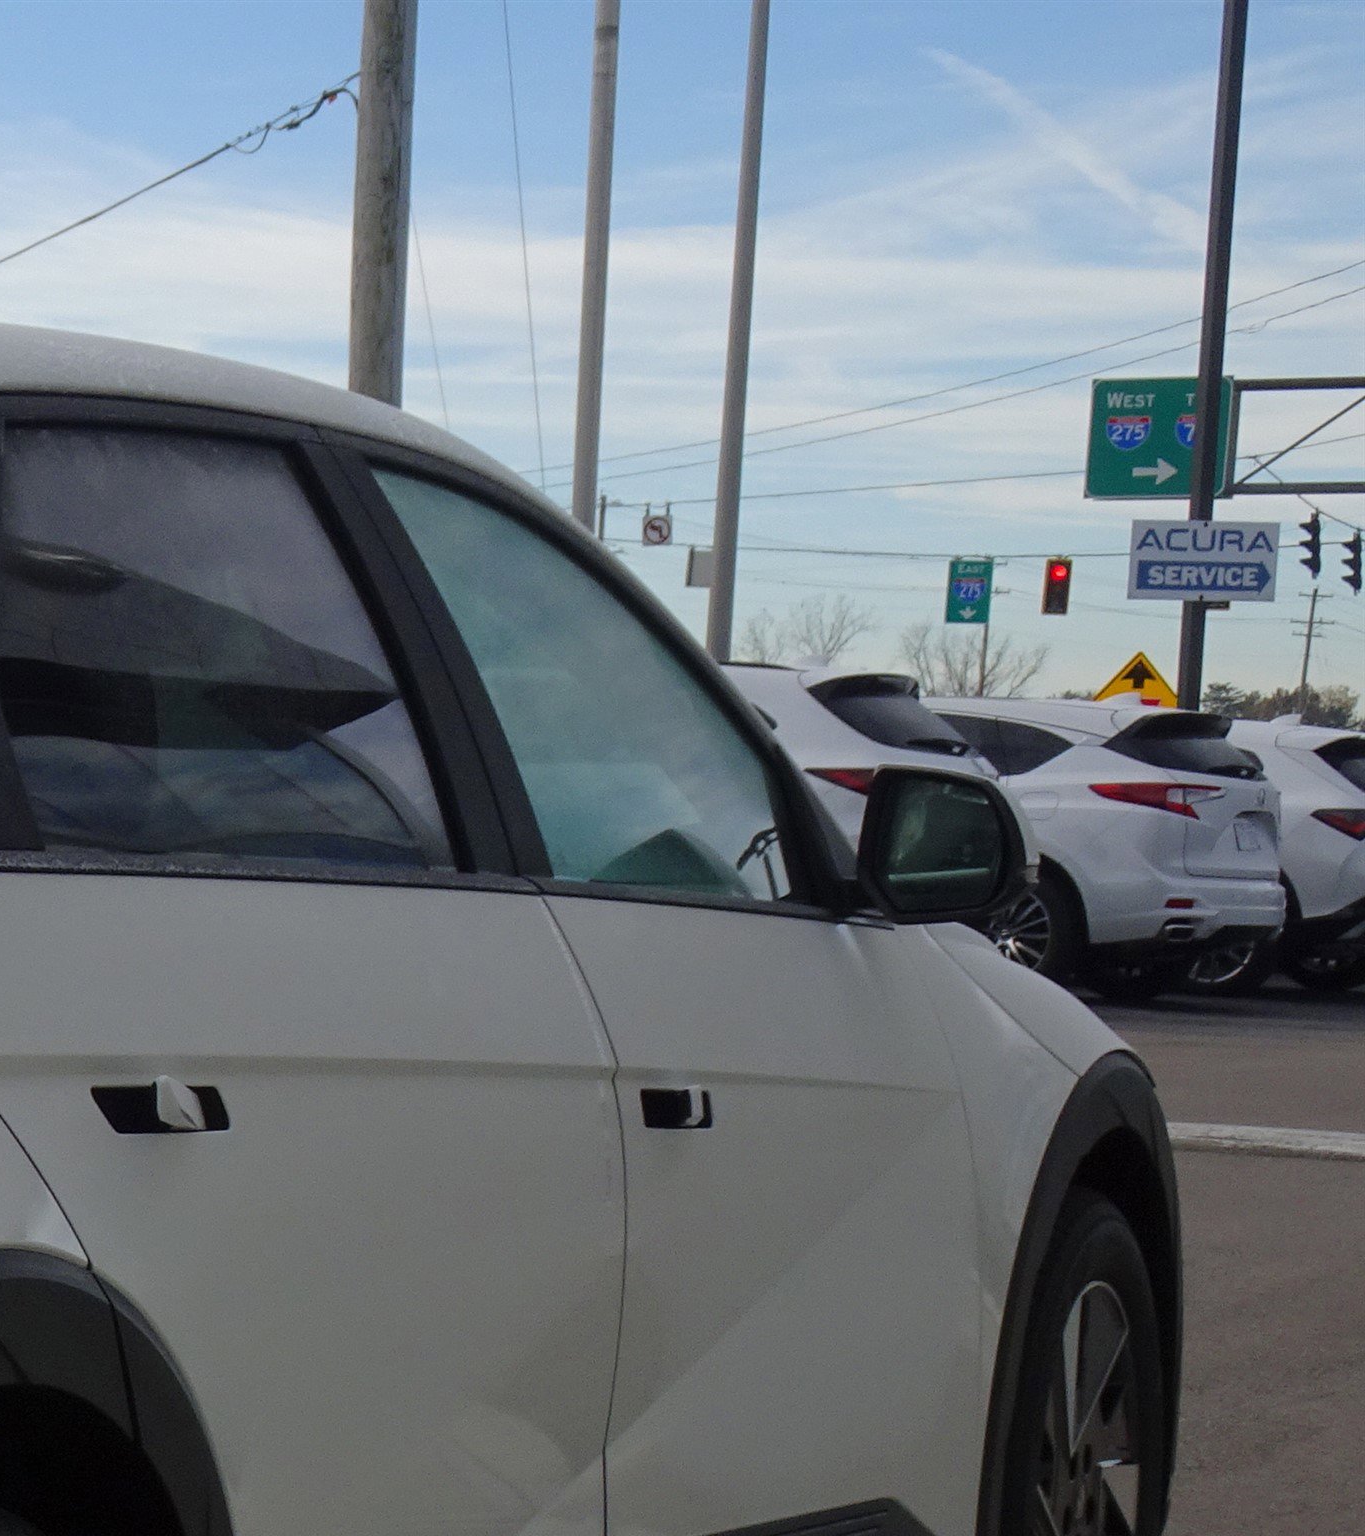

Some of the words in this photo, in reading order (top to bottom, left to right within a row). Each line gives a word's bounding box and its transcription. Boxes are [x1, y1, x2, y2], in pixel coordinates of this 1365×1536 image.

[1107, 392, 1156, 409] WEST
[1185, 393, 1197, 407] T
[1111, 424, 1145, 441] 275
[1183, 423, 1196, 441] 7
[1136, 528, 1275, 553] ACURA
[1147, 564, 1260, 588] SERVICE
[960, 582, 981, 599] 275
